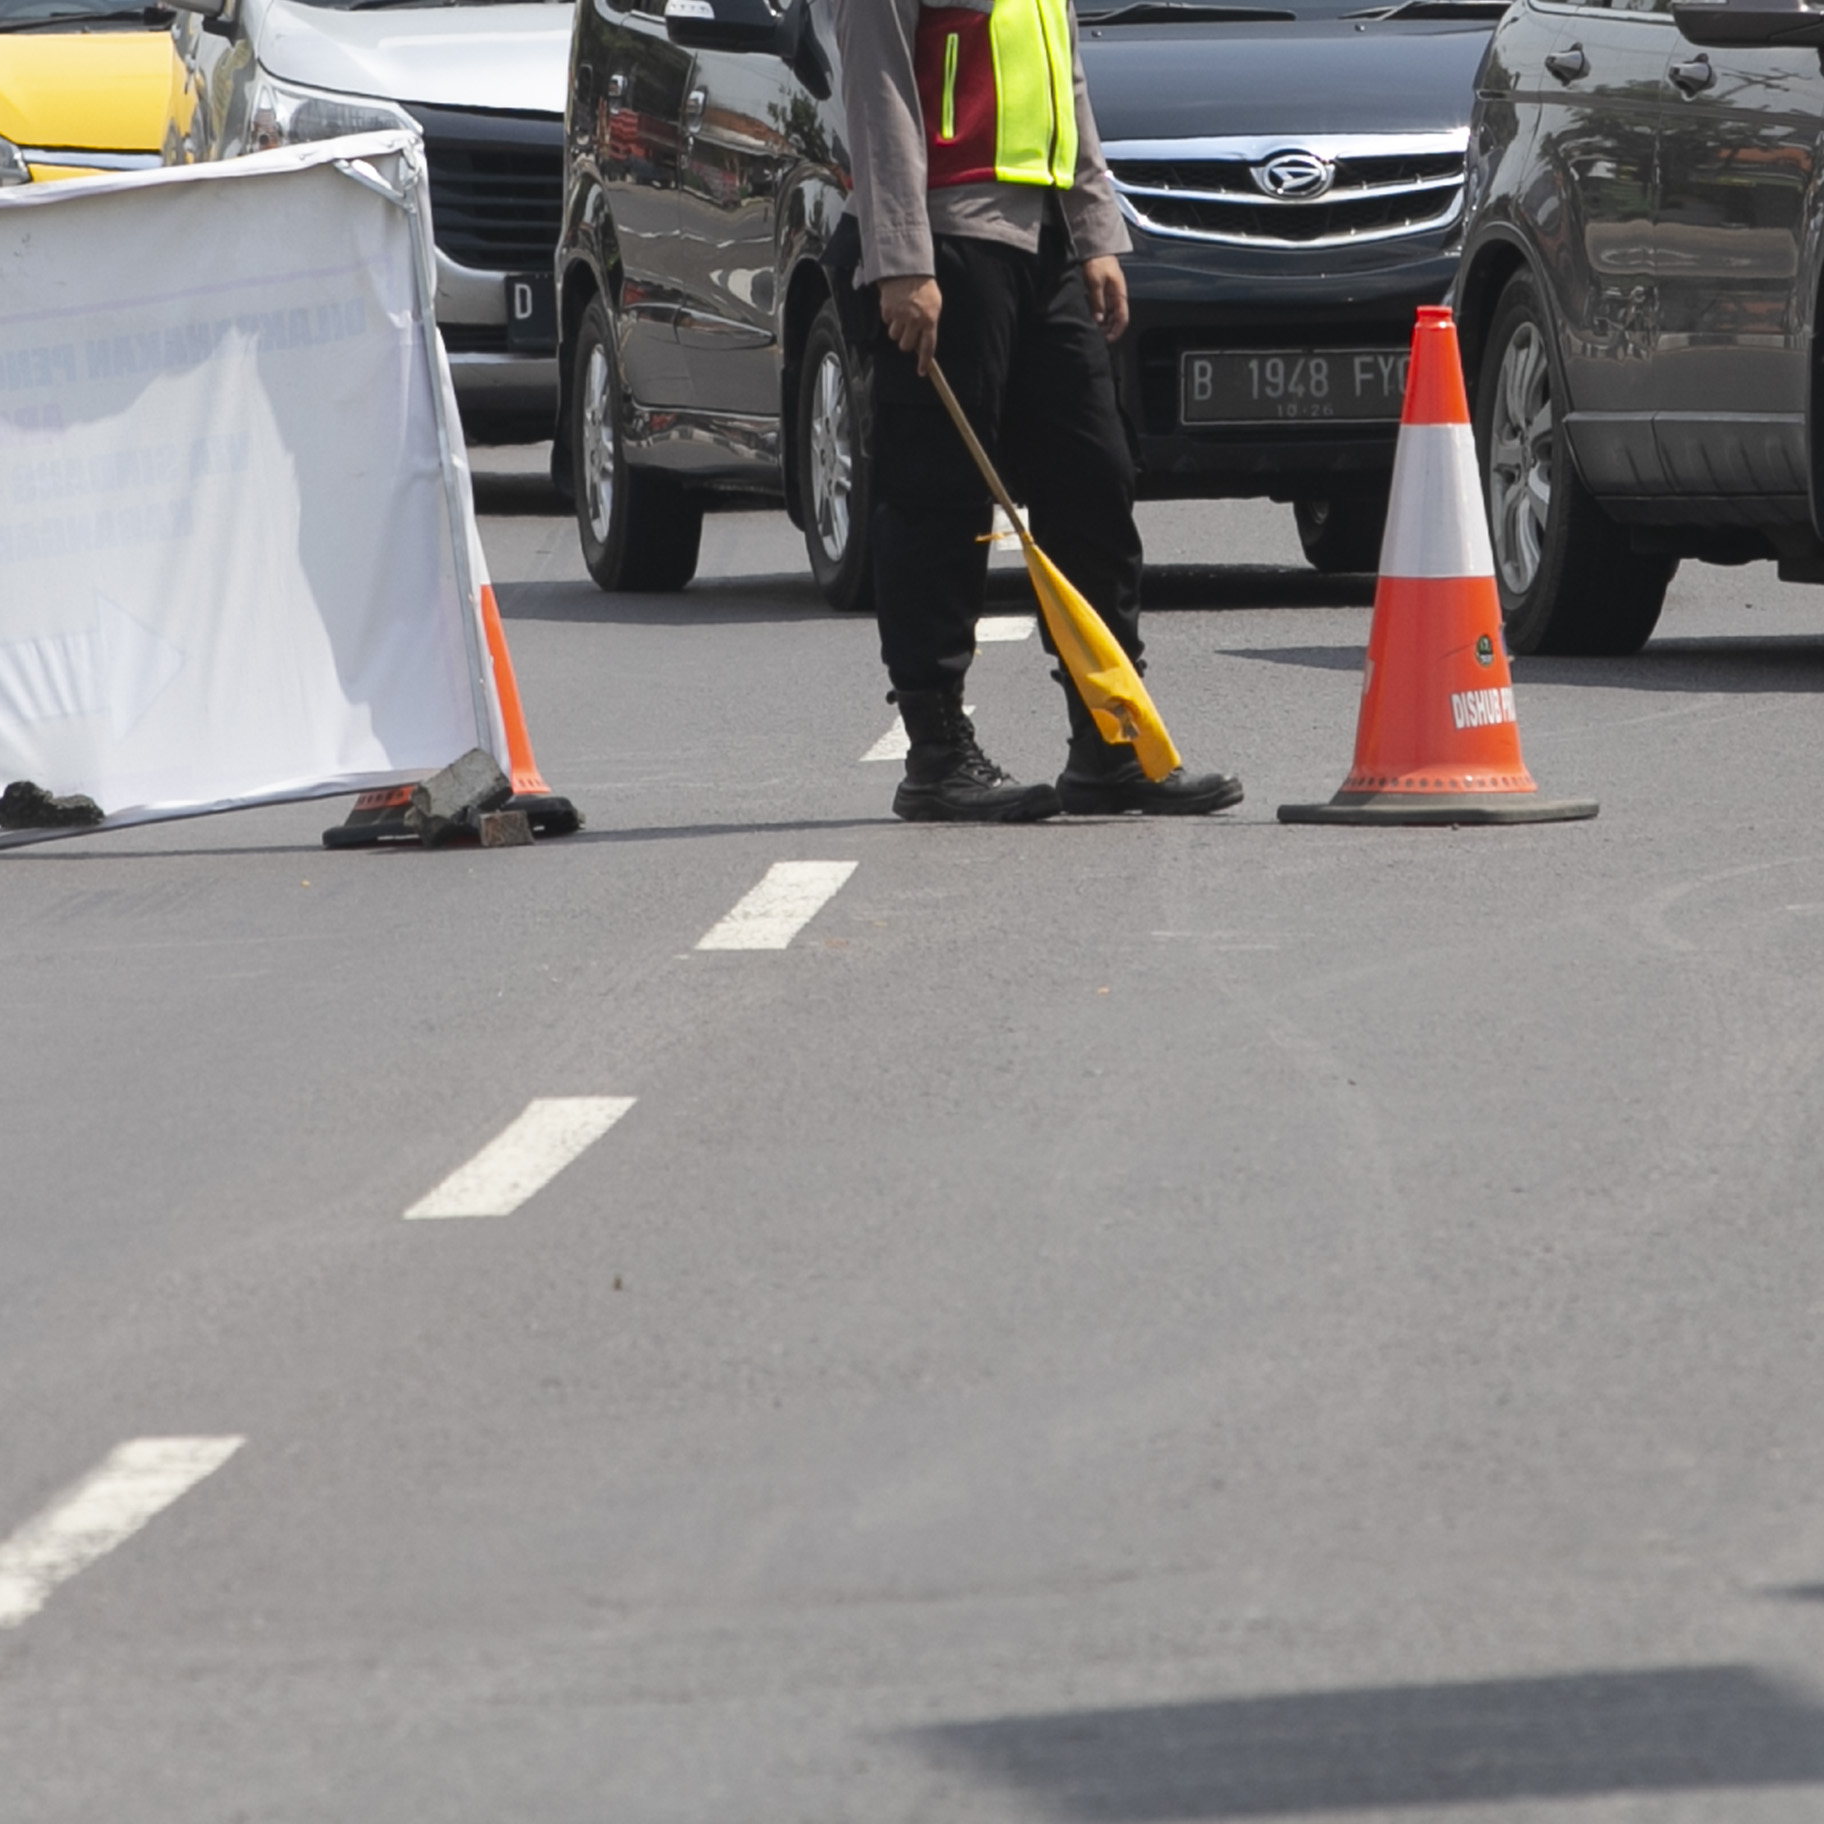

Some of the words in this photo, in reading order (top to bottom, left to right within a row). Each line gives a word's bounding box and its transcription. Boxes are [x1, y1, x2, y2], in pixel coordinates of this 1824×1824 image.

[514, 283, 533, 319] D
[1193, 360, 1213, 401] B
[1248, 357, 1330, 399] 1948
[1451, 688, 1502, 729] DISHUB
